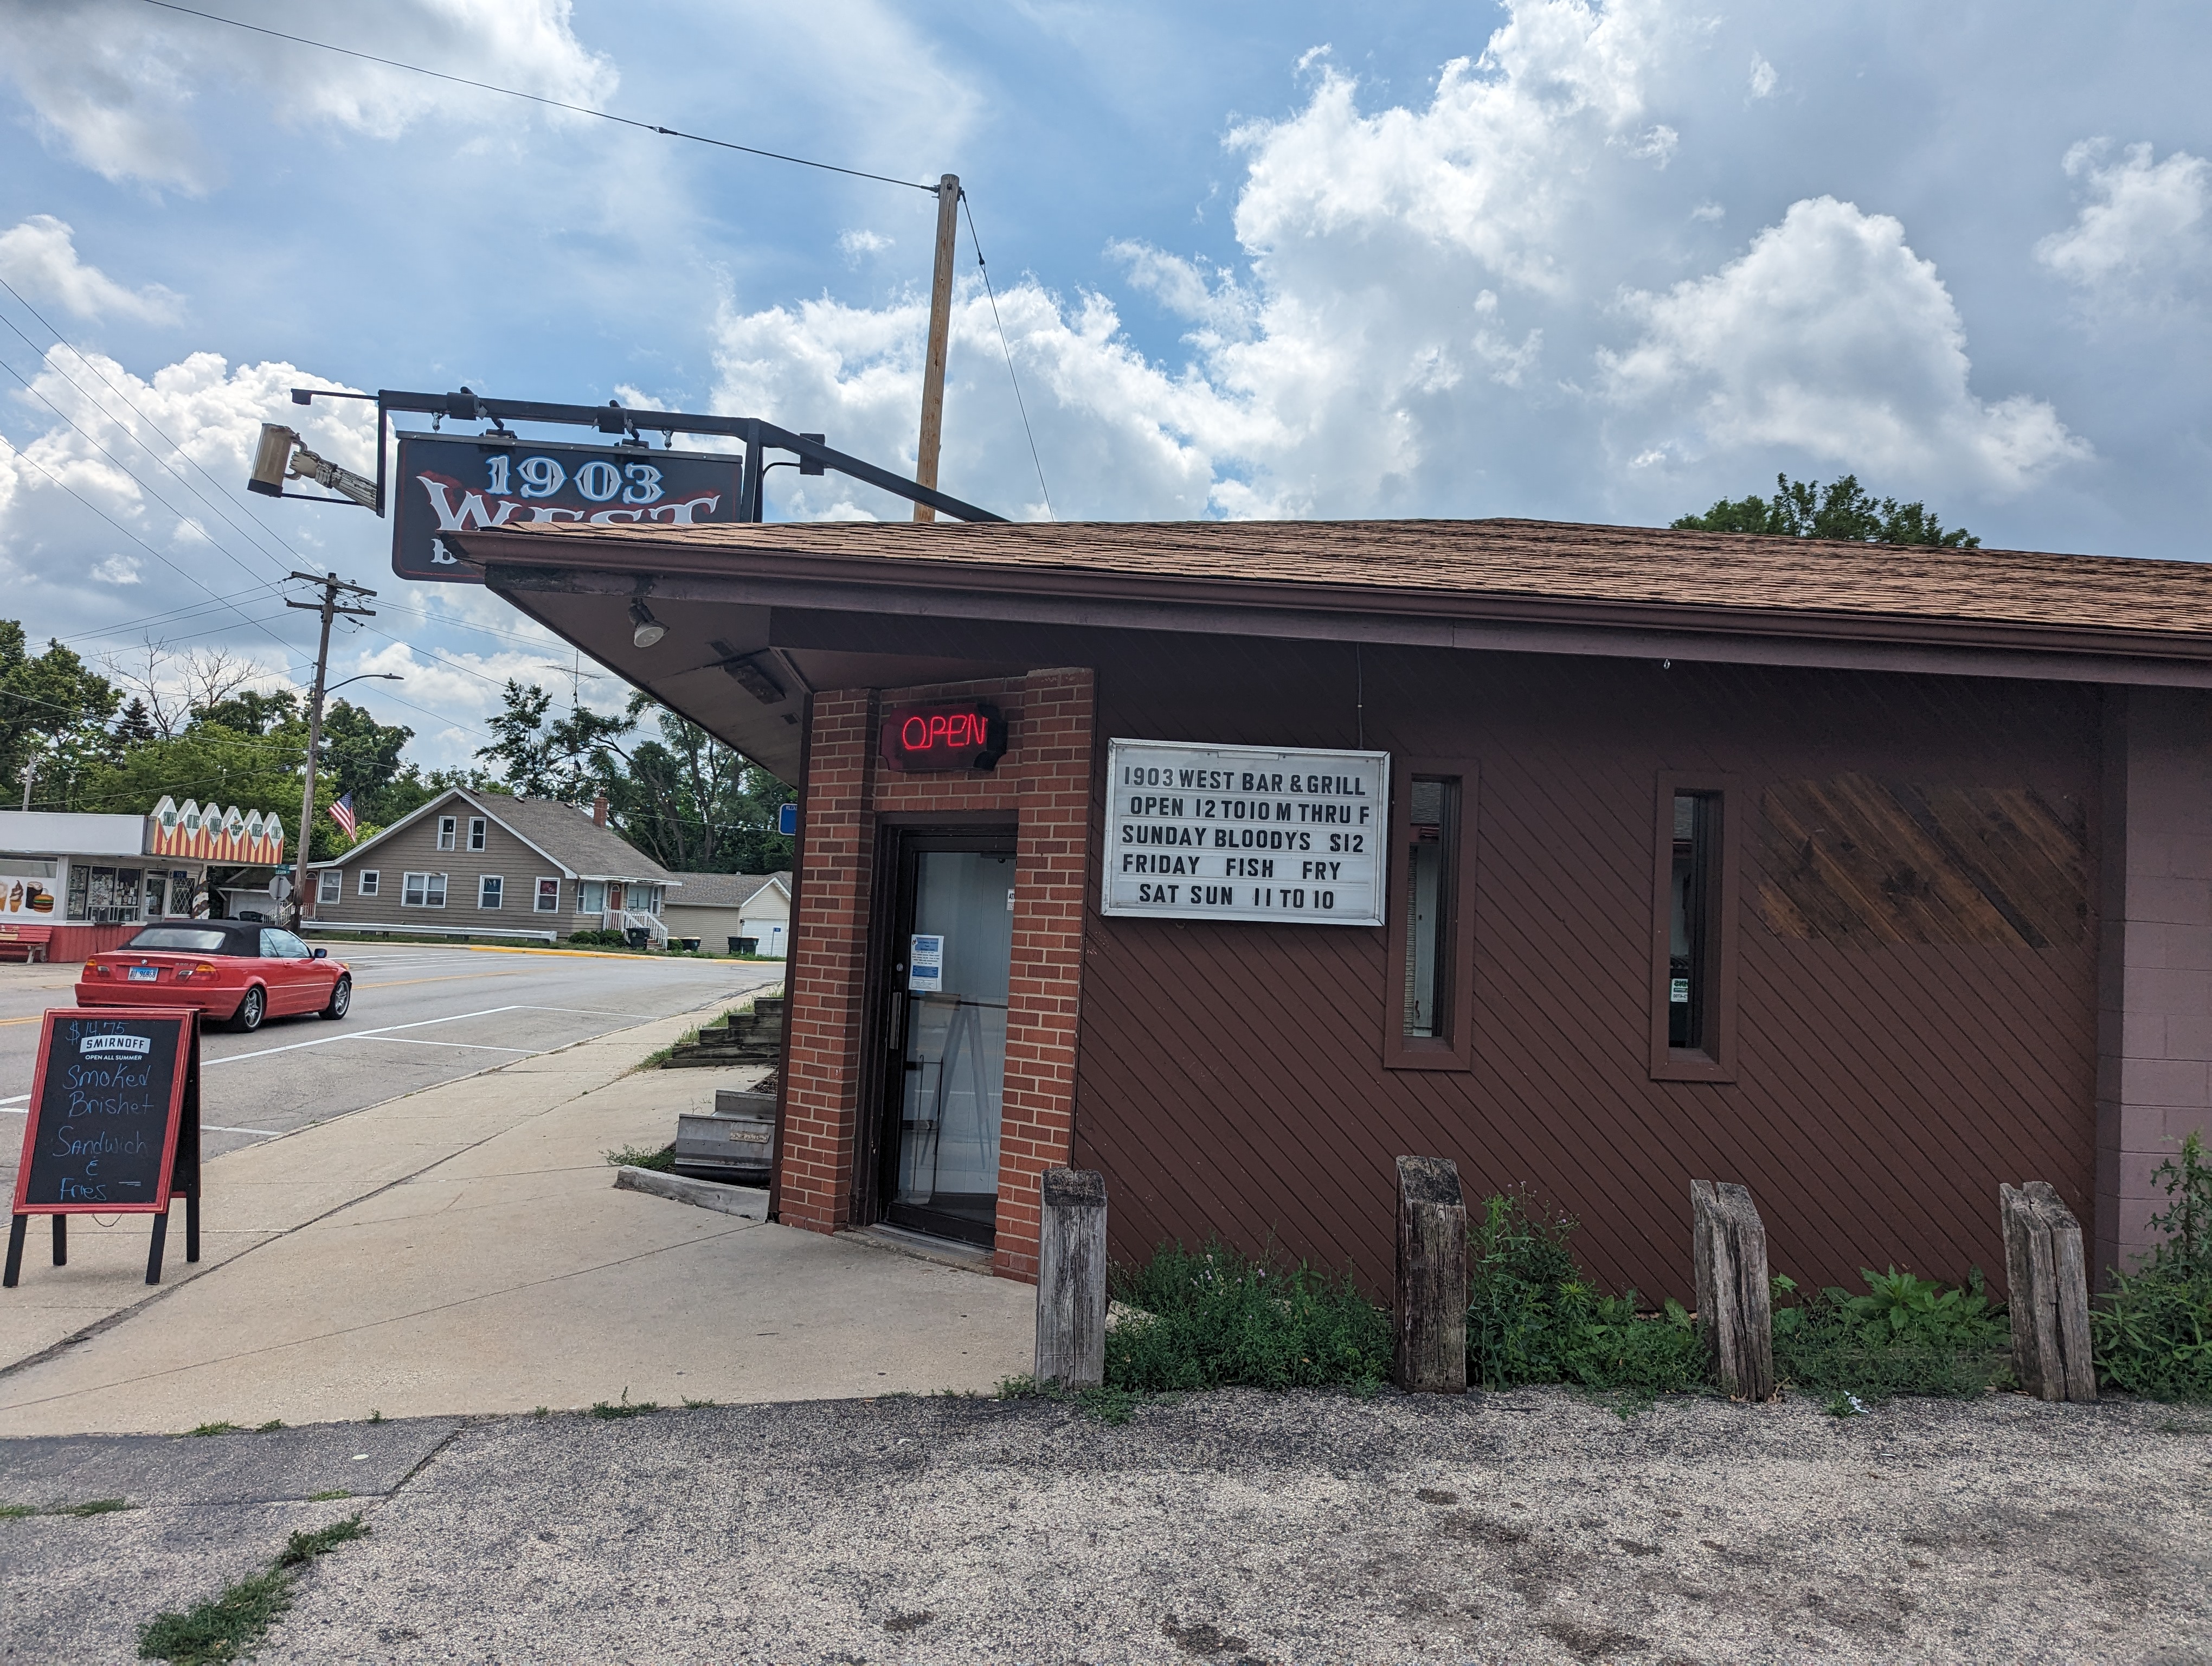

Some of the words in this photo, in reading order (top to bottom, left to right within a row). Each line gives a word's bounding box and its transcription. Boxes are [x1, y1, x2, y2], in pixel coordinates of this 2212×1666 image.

[486, 454, 666, 504] 1903
[902, 713, 988, 750] OPEN
[1125, 766, 1174, 787] 1903
[1179, 769, 1234, 790] WEST
[1242, 772, 1283, 792] BAR
[1131, 796, 1184, 817] OPEN
[1196, 798, 1216, 818] 12
[1276, 802, 1291, 821] M
[1298, 803, 1351, 823] THRU
[1359, 806, 1369, 824] F
[1122, 824, 1208, 846] SUNDAY
[1214, 829, 1311, 850] BLOODYS
[1329, 832, 1364, 853] $12
[1123, 853, 1201, 875] FRIDAY
[1226, 858, 1274, 878] FISH
[1302, 861, 1341, 880] FRY
[1139, 883, 1180, 904] SAT
[1191, 885, 1233, 905] SUN
[1254, 888, 1271, 907] 11
[1280, 888, 1304, 908] TO
[1314, 890, 1334, 909] 10
[86, 1037, 145, 1049] SMIRNOFF
[60, 1177, 107, 1201] Fries
